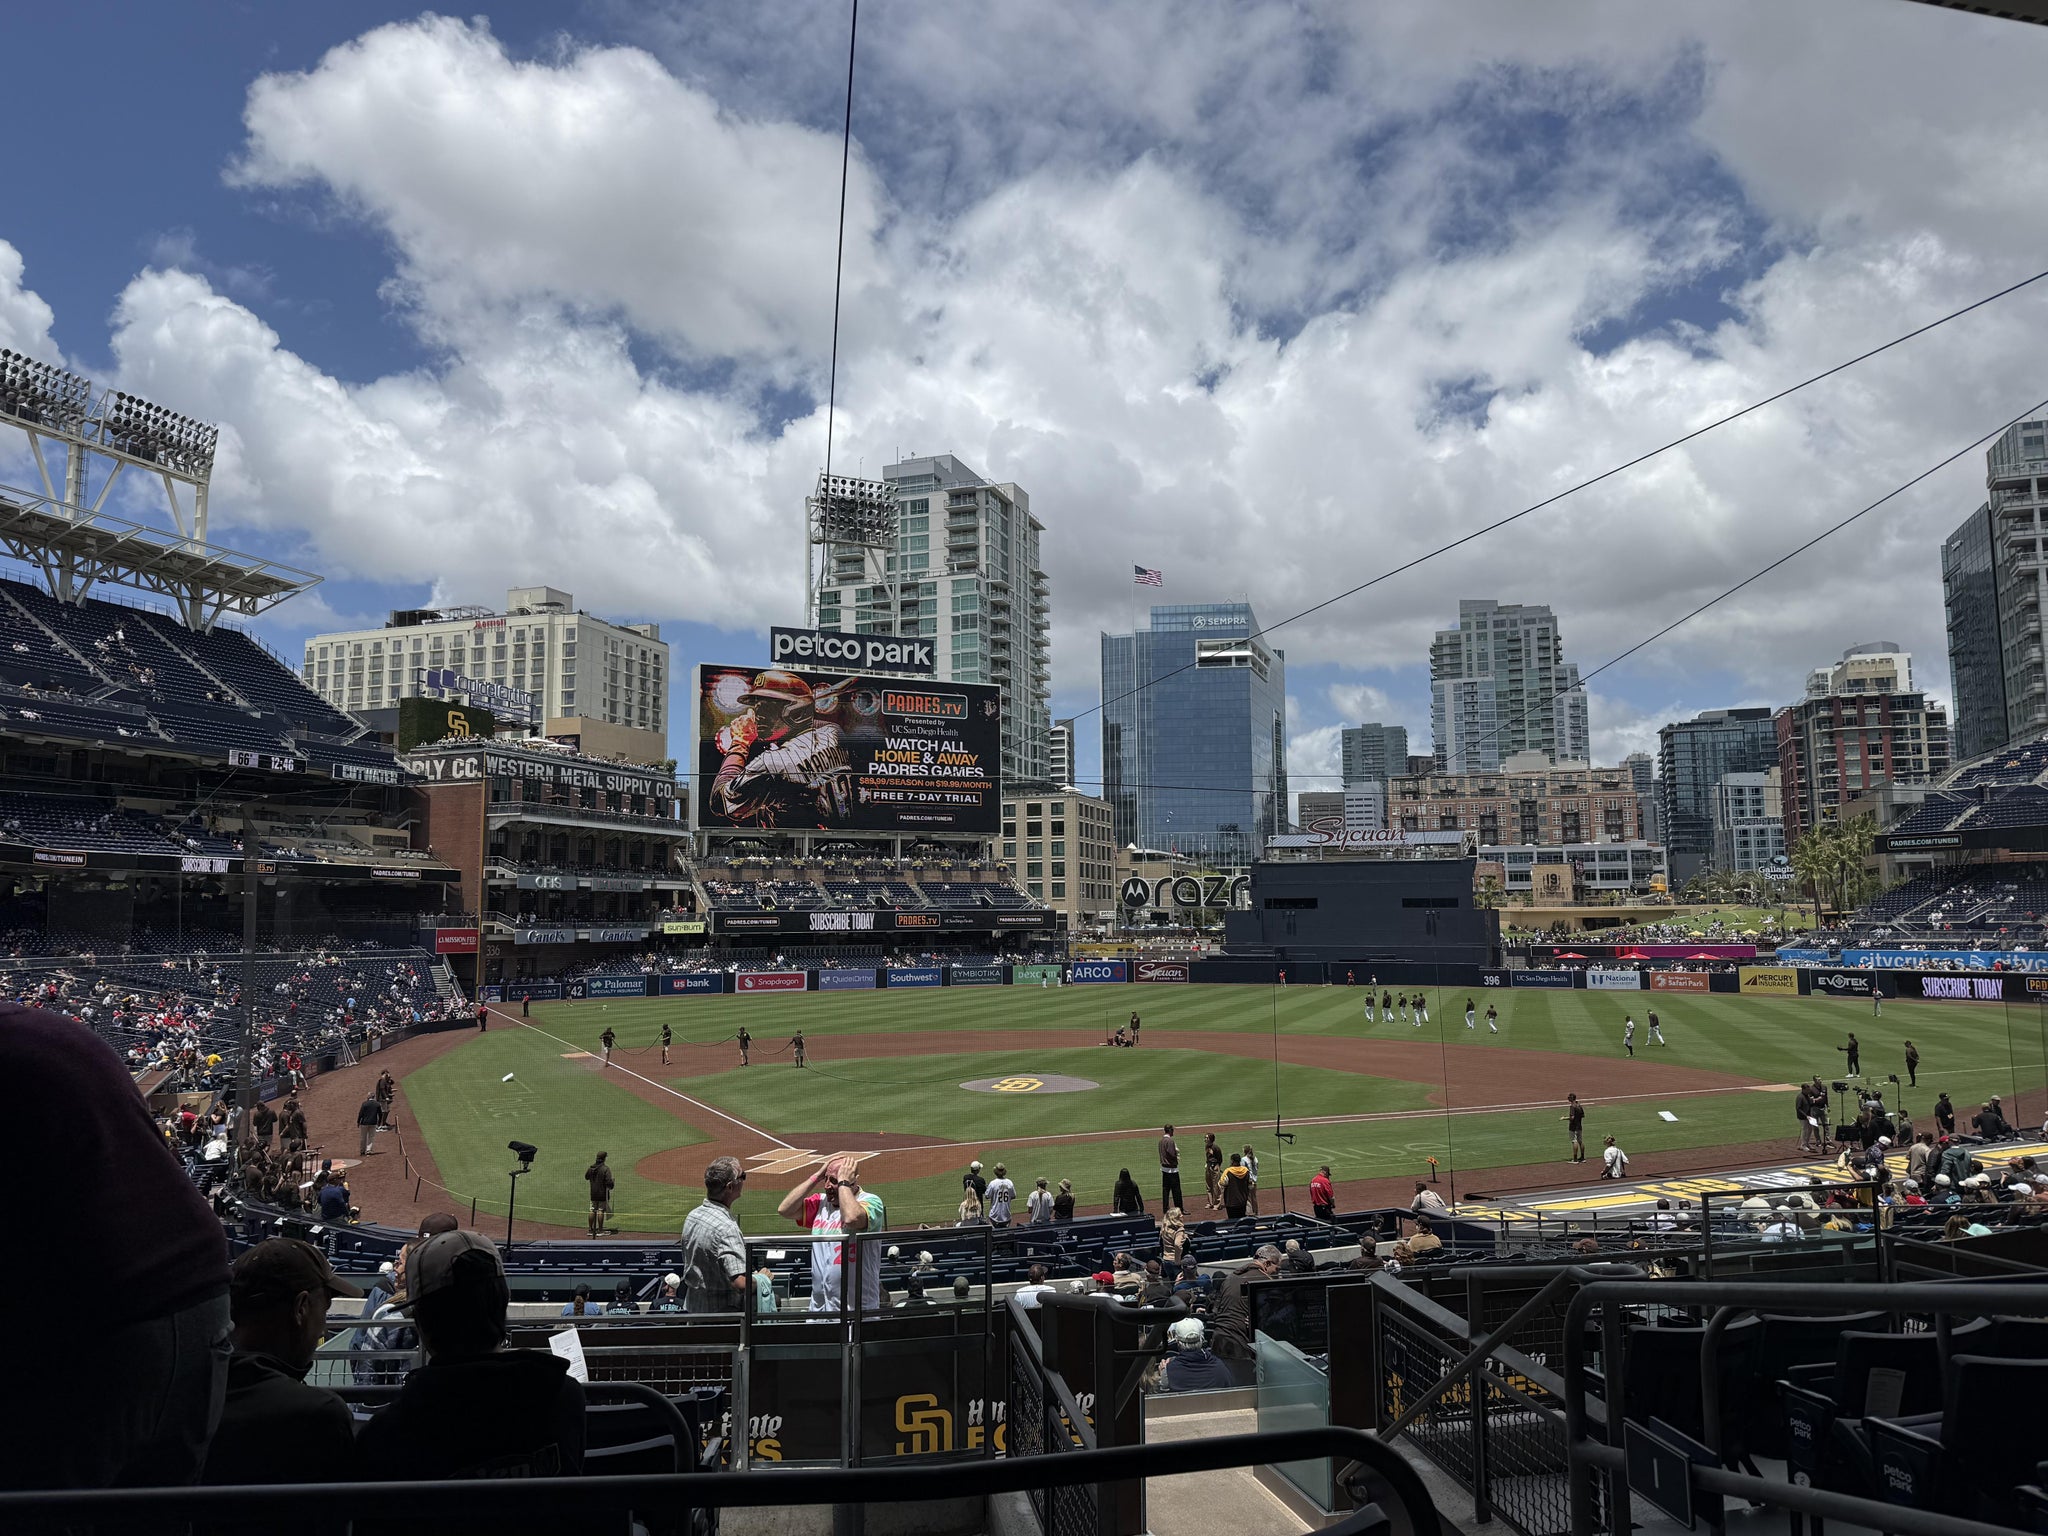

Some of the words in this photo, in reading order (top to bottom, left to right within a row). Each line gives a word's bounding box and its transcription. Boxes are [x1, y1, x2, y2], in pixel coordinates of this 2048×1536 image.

[1208, 617, 1247, 625] SEMPRA
[774, 632, 861, 660] petco
[866, 641, 931, 667] park
[887, 693, 962, 715] PADRES.TV
[905, 717, 936, 726] Presented
[892, 725, 903, 733] UC
[903, 725, 917, 734] San
[917, 726, 936, 736] Diego
[937, 728, 959, 736] Health
[885, 737, 938, 751] WATCH
[941, 741, 968, 753] ALL
[271, 757, 294, 771] 12:46
[874, 750, 920, 763] HOME
[923, 751, 935, 764] &
[937, 753, 979, 766] AWAY
[452, 757, 482, 779] CO.
[868, 762, 929, 776] PADRES
[931, 765, 984, 778] GAMES
[485, 754, 554, 782] WESTERN
[560, 767, 603, 789] METAL
[606, 775, 652, 796] SUPPLY
[656, 782, 674, 799] CO.
[936, 780, 992, 789] $19.99/MONTH
[873, 791, 904, 800] FREE
[908, 792, 942, 802] 7-DAY
[944, 794, 979, 803] TRIAL
[1307, 816, 1408, 851] Sycuan
[1155, 875, 1250, 907] razr
[809, 913, 851, 931] SUBSCRIBE
[851, 912, 875, 930] TODAY
[898, 915, 938, 925] PADRES.TV
[890, 973, 932, 982] Southwest
[1074, 967, 1111, 978] ARCO
[1138, 963, 1183, 981] Sycuan
[1605, 974, 1637, 982] National
[1758, 974, 1793, 982] MERCURY
[604, 980, 643, 989] Palomar
[673, 980, 685, 988] us
[686, 979, 709, 987] bank
[758, 977, 799, 986] Snapdragon
[832, 975, 874, 983] QuidelOrtho
[1483, 975, 1500, 986] 396
[1536, 975, 1551, 983] Diego
[1818, 974, 1869, 989] EVOTEK
[570, 986, 583, 996] 42
[1921, 977, 1971, 998] SUBSCRIBE
[1972, 978, 2003, 999] TODAY
[998, 1191, 1009, 1203] 26
[1789, 1416, 1813, 1432] petco
[1793, 1426, 1813, 1441] park
[1883, 1464, 1912, 1484] petco
[1889, 1475, 1913, 1494] park
